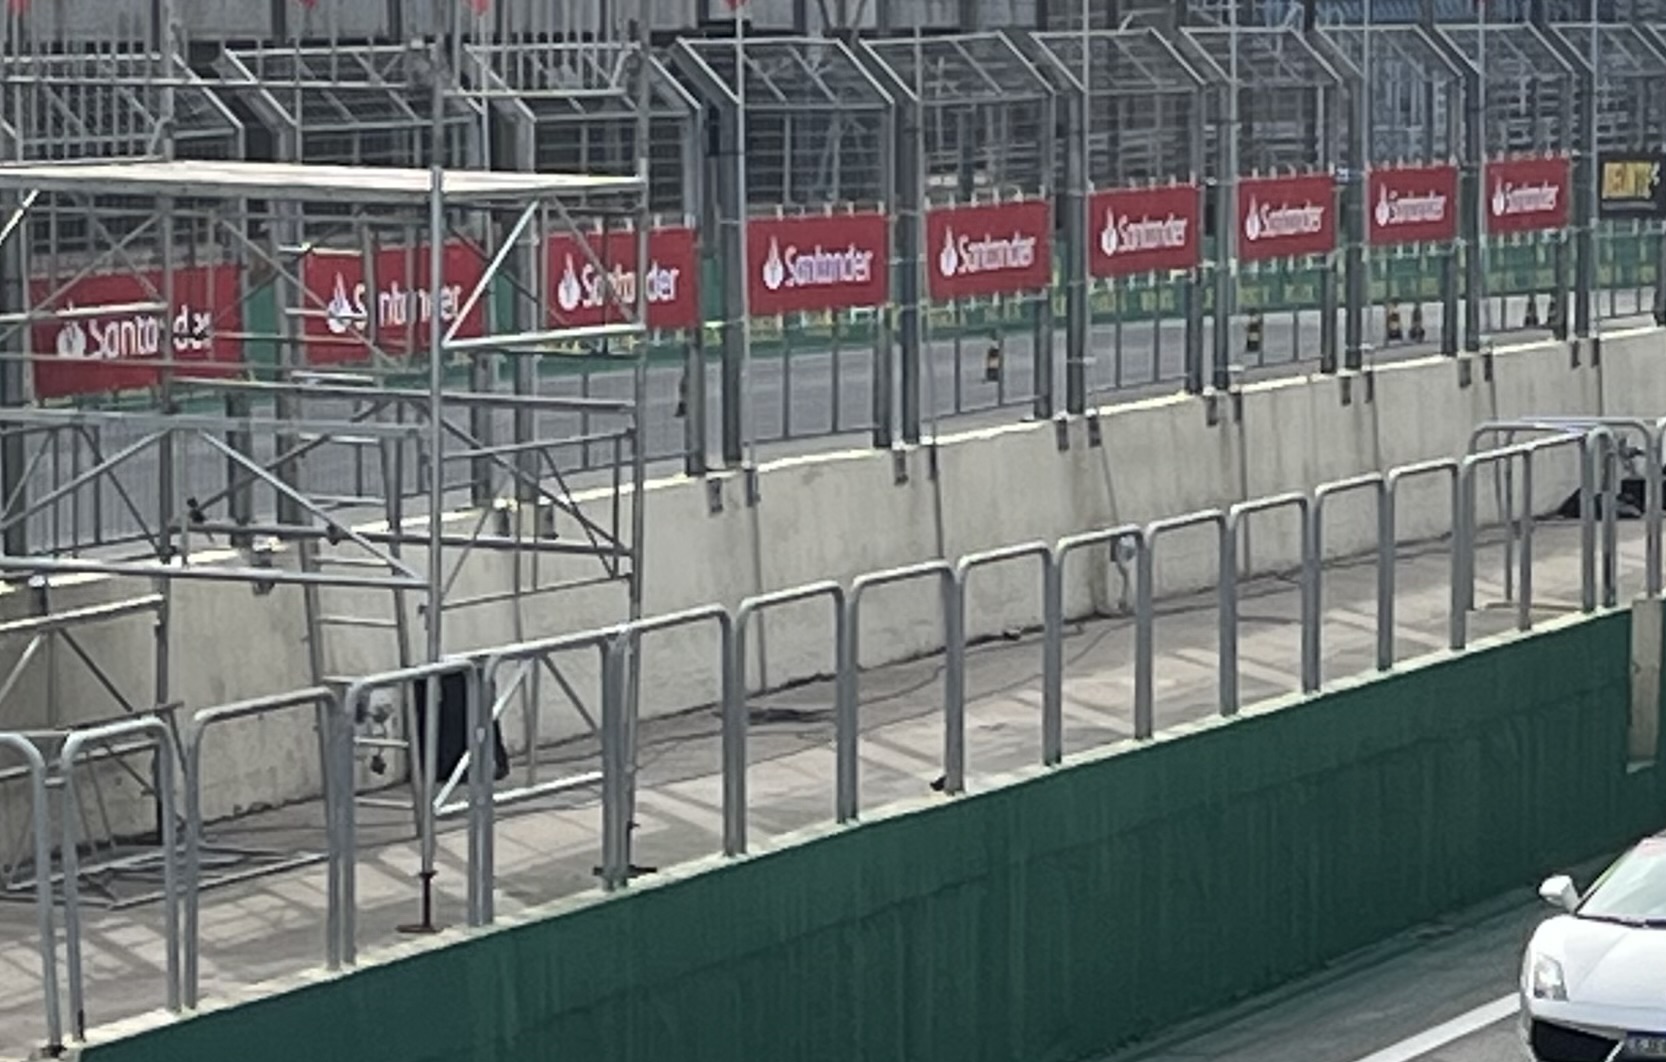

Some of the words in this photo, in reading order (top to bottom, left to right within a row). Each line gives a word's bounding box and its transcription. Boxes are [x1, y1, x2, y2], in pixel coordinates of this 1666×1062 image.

[1117, 212, 1188, 252] Santander
[1260, 200, 1325, 238] Santander
[785, 243, 873, 287] Santander
[957, 231, 1037, 274] Santander
